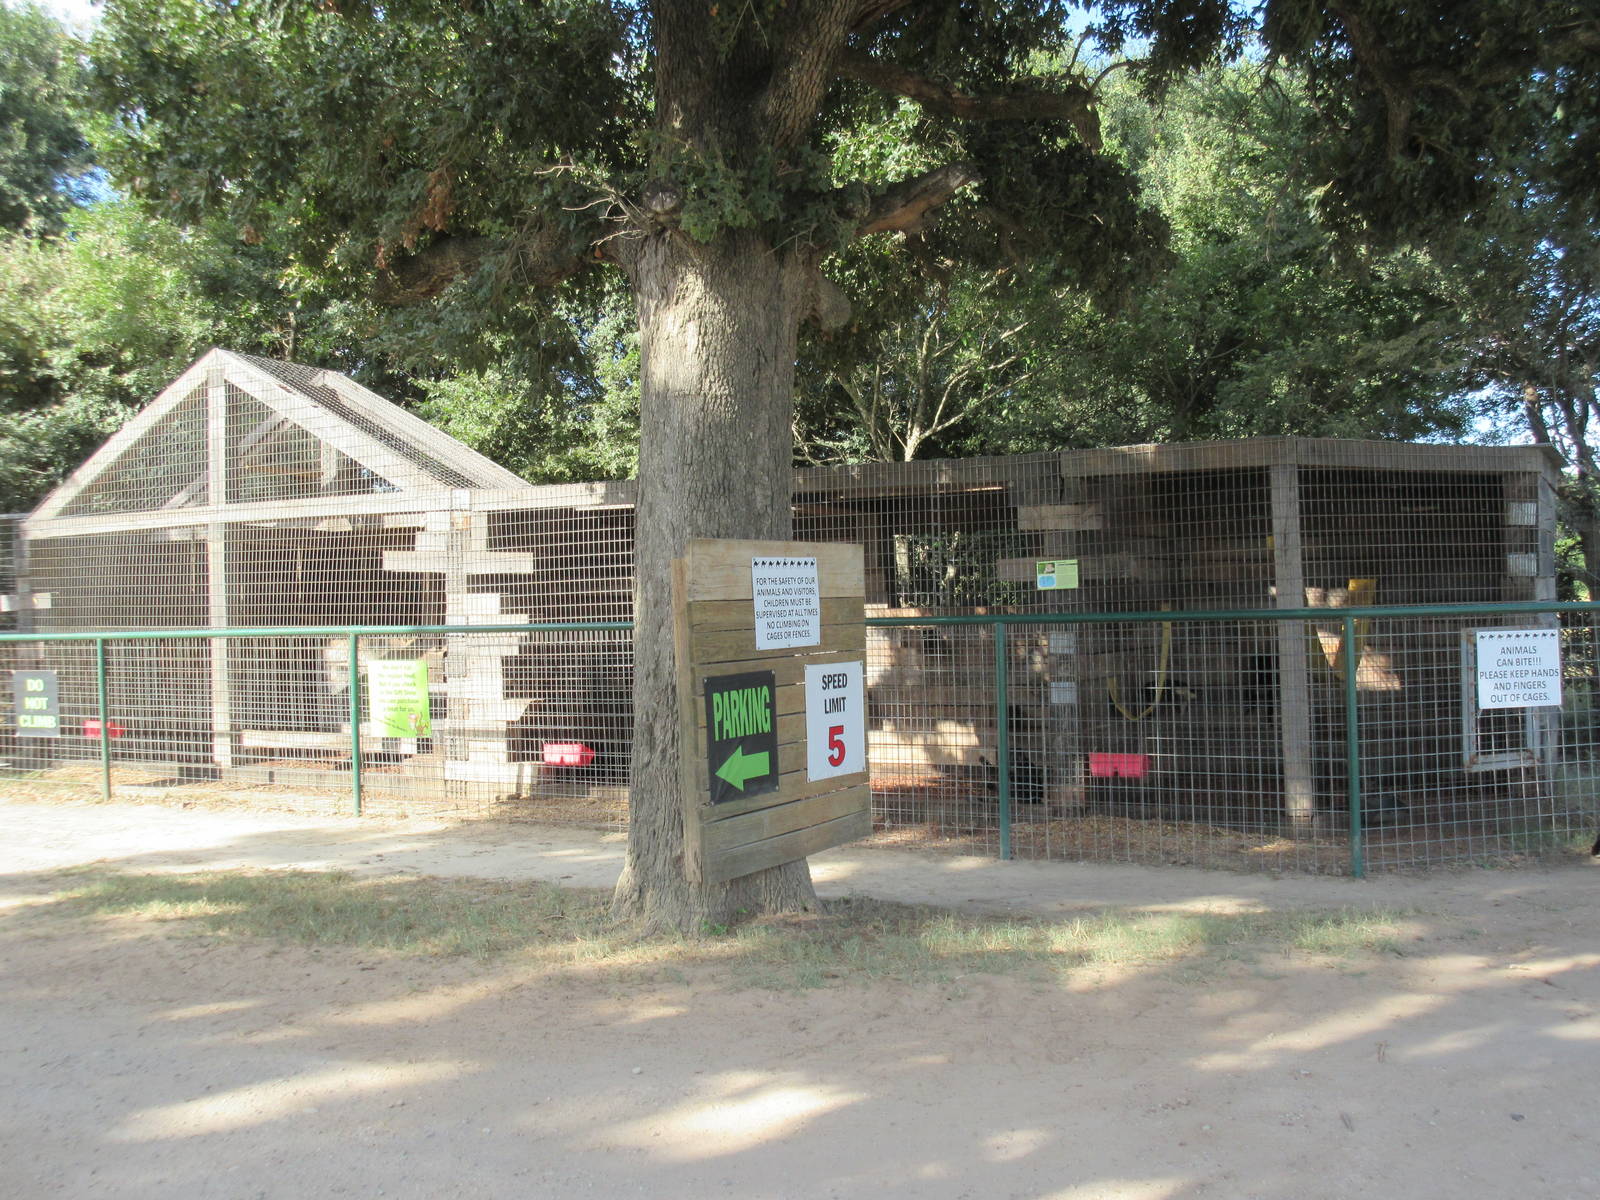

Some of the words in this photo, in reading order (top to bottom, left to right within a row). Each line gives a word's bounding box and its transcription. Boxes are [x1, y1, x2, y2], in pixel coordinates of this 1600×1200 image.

[756, 578, 767, 586] FOR
[768, 577, 777, 585] THE
[779, 577, 796, 585] SAFETY
[797, 577, 804, 585] OF
[805, 576, 815, 584] OUR
[757, 588, 780, 596] ANIMALS
[782, 588, 793, 596] AND
[764, 599, 789, 607] CHILDREN
[790, 598, 804, 606] MUST
[756, 610, 787, 619] SUPERVISED
[788, 609, 794, 617] AT
[767, 621, 775, 629] NO
[776, 620, 800, 628] CLIMBING
[767, 632, 783, 640] CAGES
[784, 631, 791, 640] OR
[1500, 646, 1537, 655] ANIMALS
[1496, 658, 1513, 667] CAN
[1516, 657, 1541, 666] BITE!!!
[1480, 670, 1507, 679] PLEASE
[1510, 670, 1529, 678] KEEP
[1532, 668, 1559, 677] HANDS
[26, 679, 45, 692] DO
[822, 673, 848, 690] SPEED
[1493, 682, 1511, 690] AND
[1514, 681, 1546, 689] FINGERS
[1490, 694, 1507, 703] OUT
[1510, 694, 1520, 702] OF
[1522, 692, 1550, 701] CAGES.
[24, 697, 48, 710] NOT
[824, 697, 846, 714] LIMIT
[712, 686, 771, 741] PARKING
[19, 715, 57, 728] CLIMB
[828, 725, 846, 767] 5
